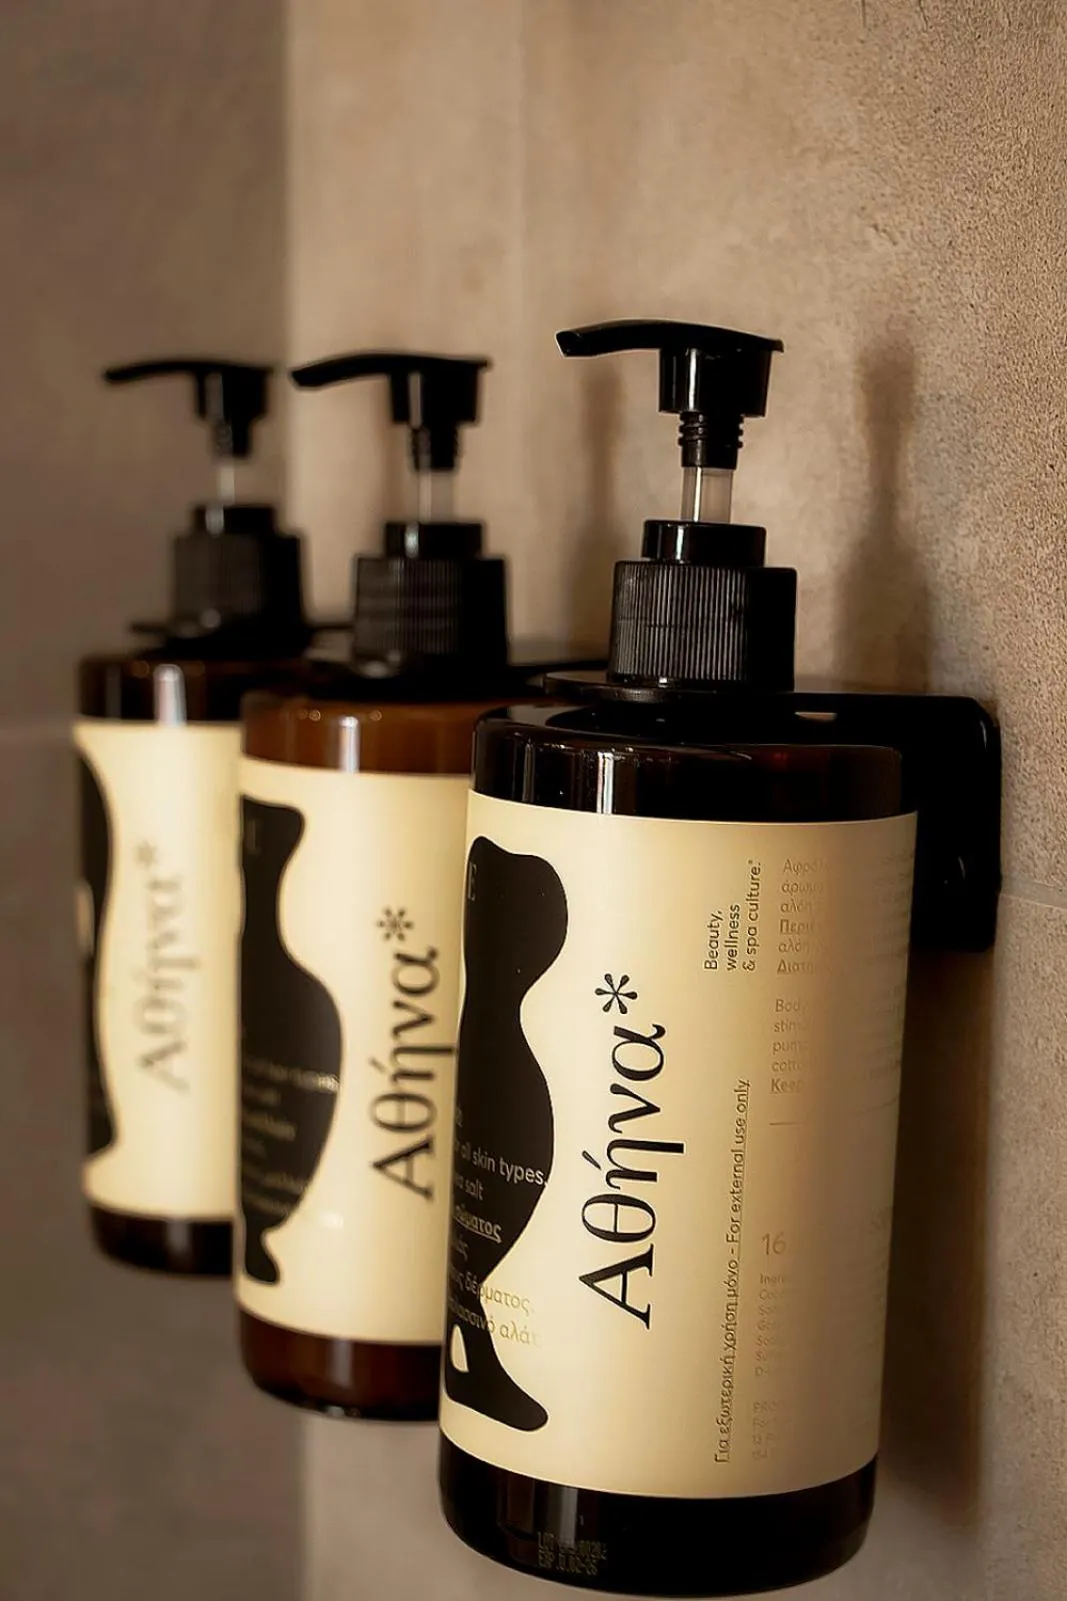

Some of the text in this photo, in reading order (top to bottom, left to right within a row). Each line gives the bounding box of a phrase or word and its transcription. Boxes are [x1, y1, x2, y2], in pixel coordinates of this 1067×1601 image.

[704, 910, 723, 970] Beauty,
[726, 903, 740, 971] wellness
[746, 926, 760, 962] spa
[742, 962, 756, 972] &
[734, 1079, 750, 1114] only
[735, 1117, 748, 1144] use
[472, 1147, 495, 1173] skin
[730, 1148, 745, 1214] external
[726, 1216, 741, 1244] For
[723, 1259, 740, 1299] μόνο
[721, 1302, 738, 1351] χρήση
[716, 1354, 736, 1435] εξωτερική
[714, 1439, 731, 1464] Για
